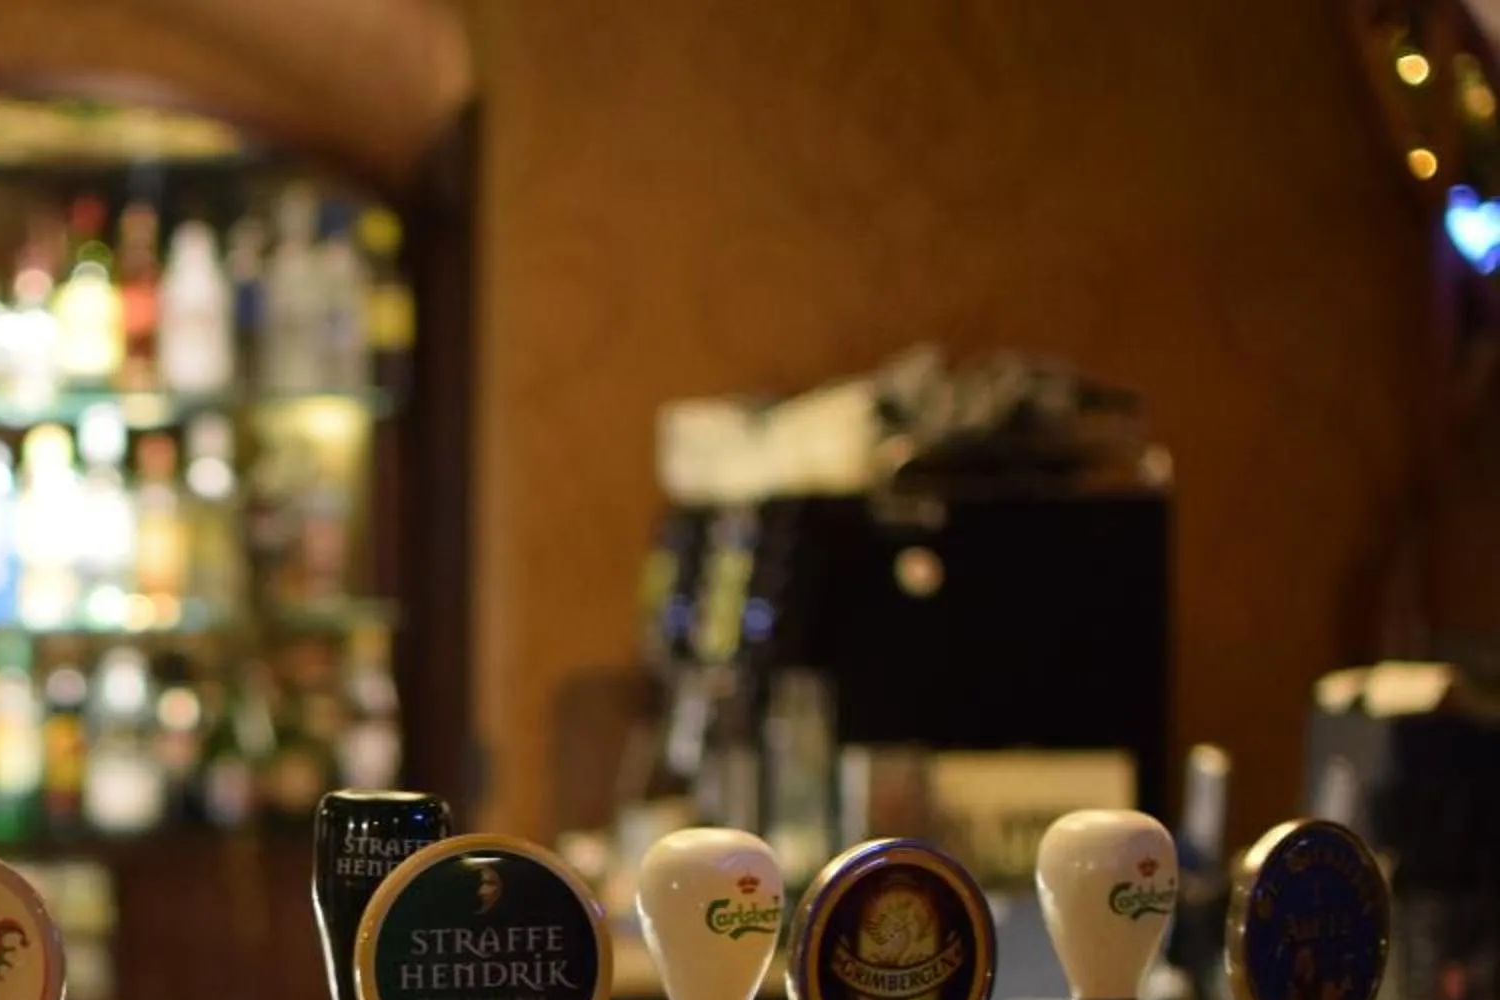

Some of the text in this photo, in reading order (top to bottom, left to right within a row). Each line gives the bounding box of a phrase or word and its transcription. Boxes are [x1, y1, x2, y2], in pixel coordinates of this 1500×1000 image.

[343, 836, 434, 857] STRAFF
[705, 897, 781, 938] Carlsber
[409, 925, 564, 957] STRAFFE
